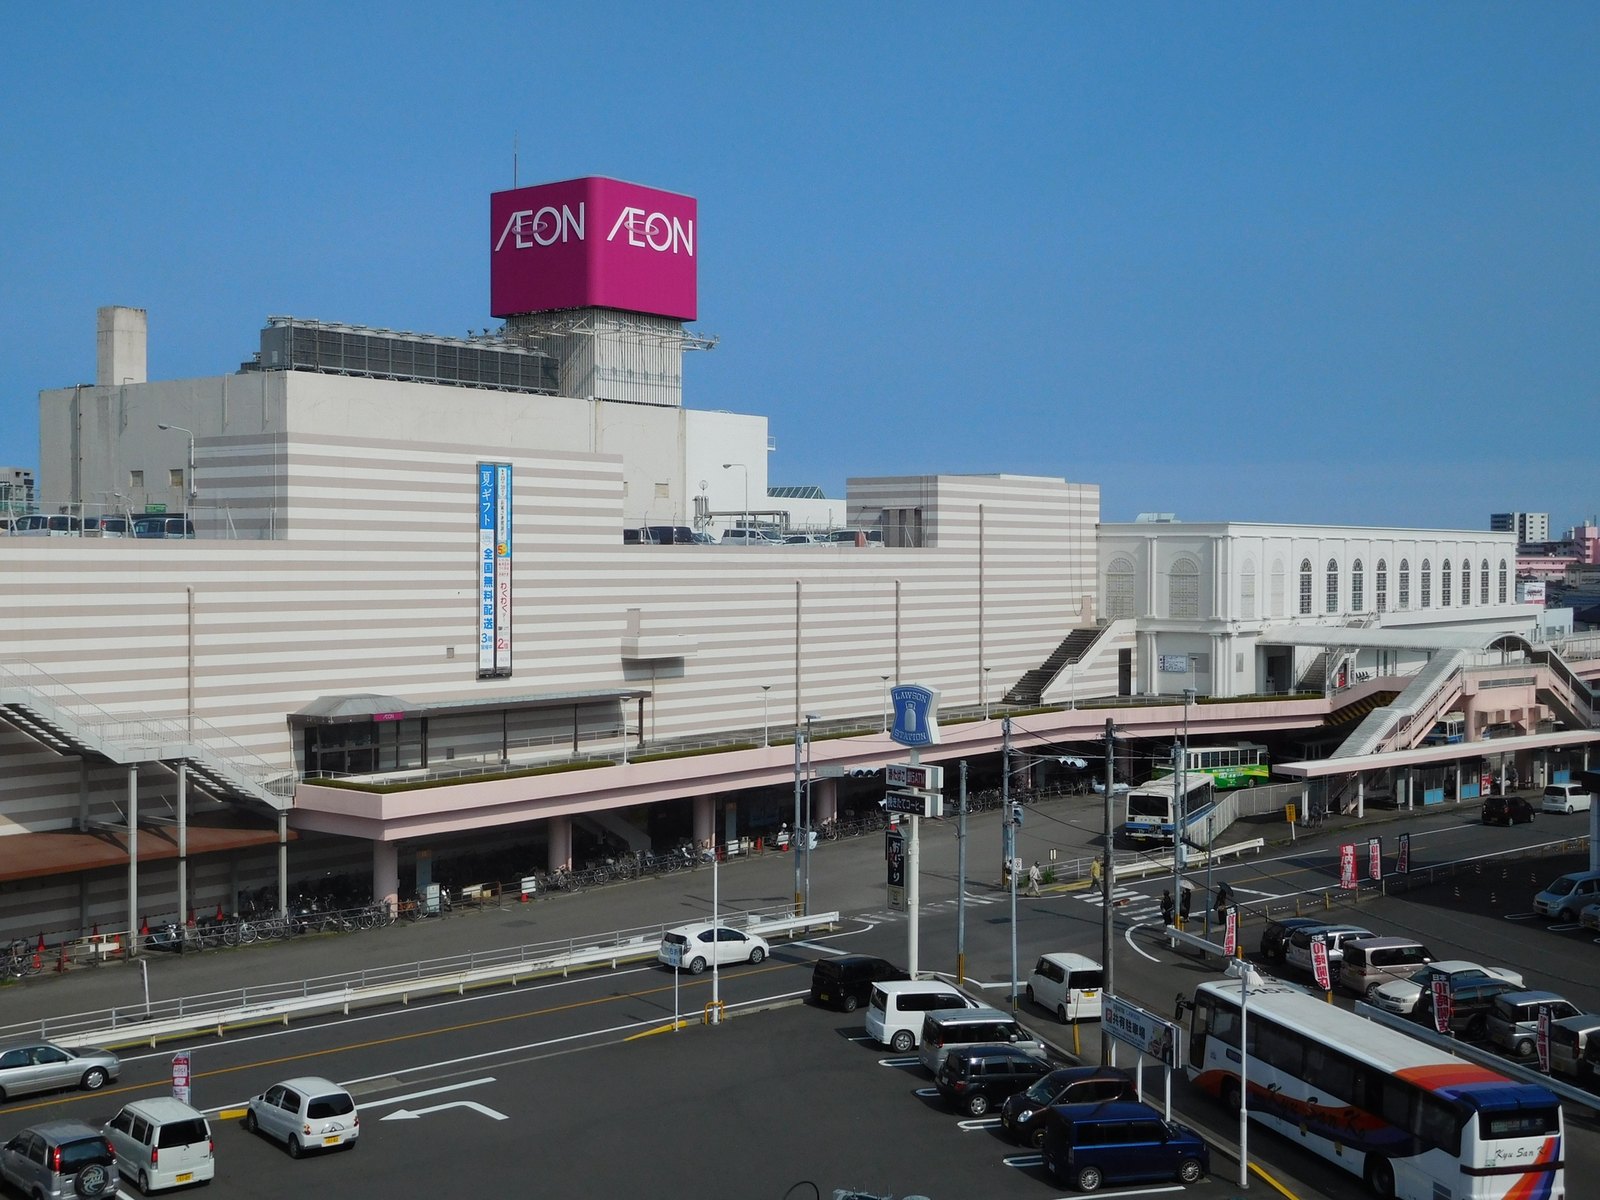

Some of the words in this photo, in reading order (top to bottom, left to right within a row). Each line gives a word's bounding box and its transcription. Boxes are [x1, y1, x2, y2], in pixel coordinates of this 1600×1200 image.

[481, 470, 493, 526] 夏ギフト
[484, 548, 493, 629] 全国無料配送
[895, 691, 928, 703] LAWSON
[894, 728, 927, 741] STATION
[1496, 1149, 1514, 1161] Kyu
[1516, 1147, 1534, 1158] San
